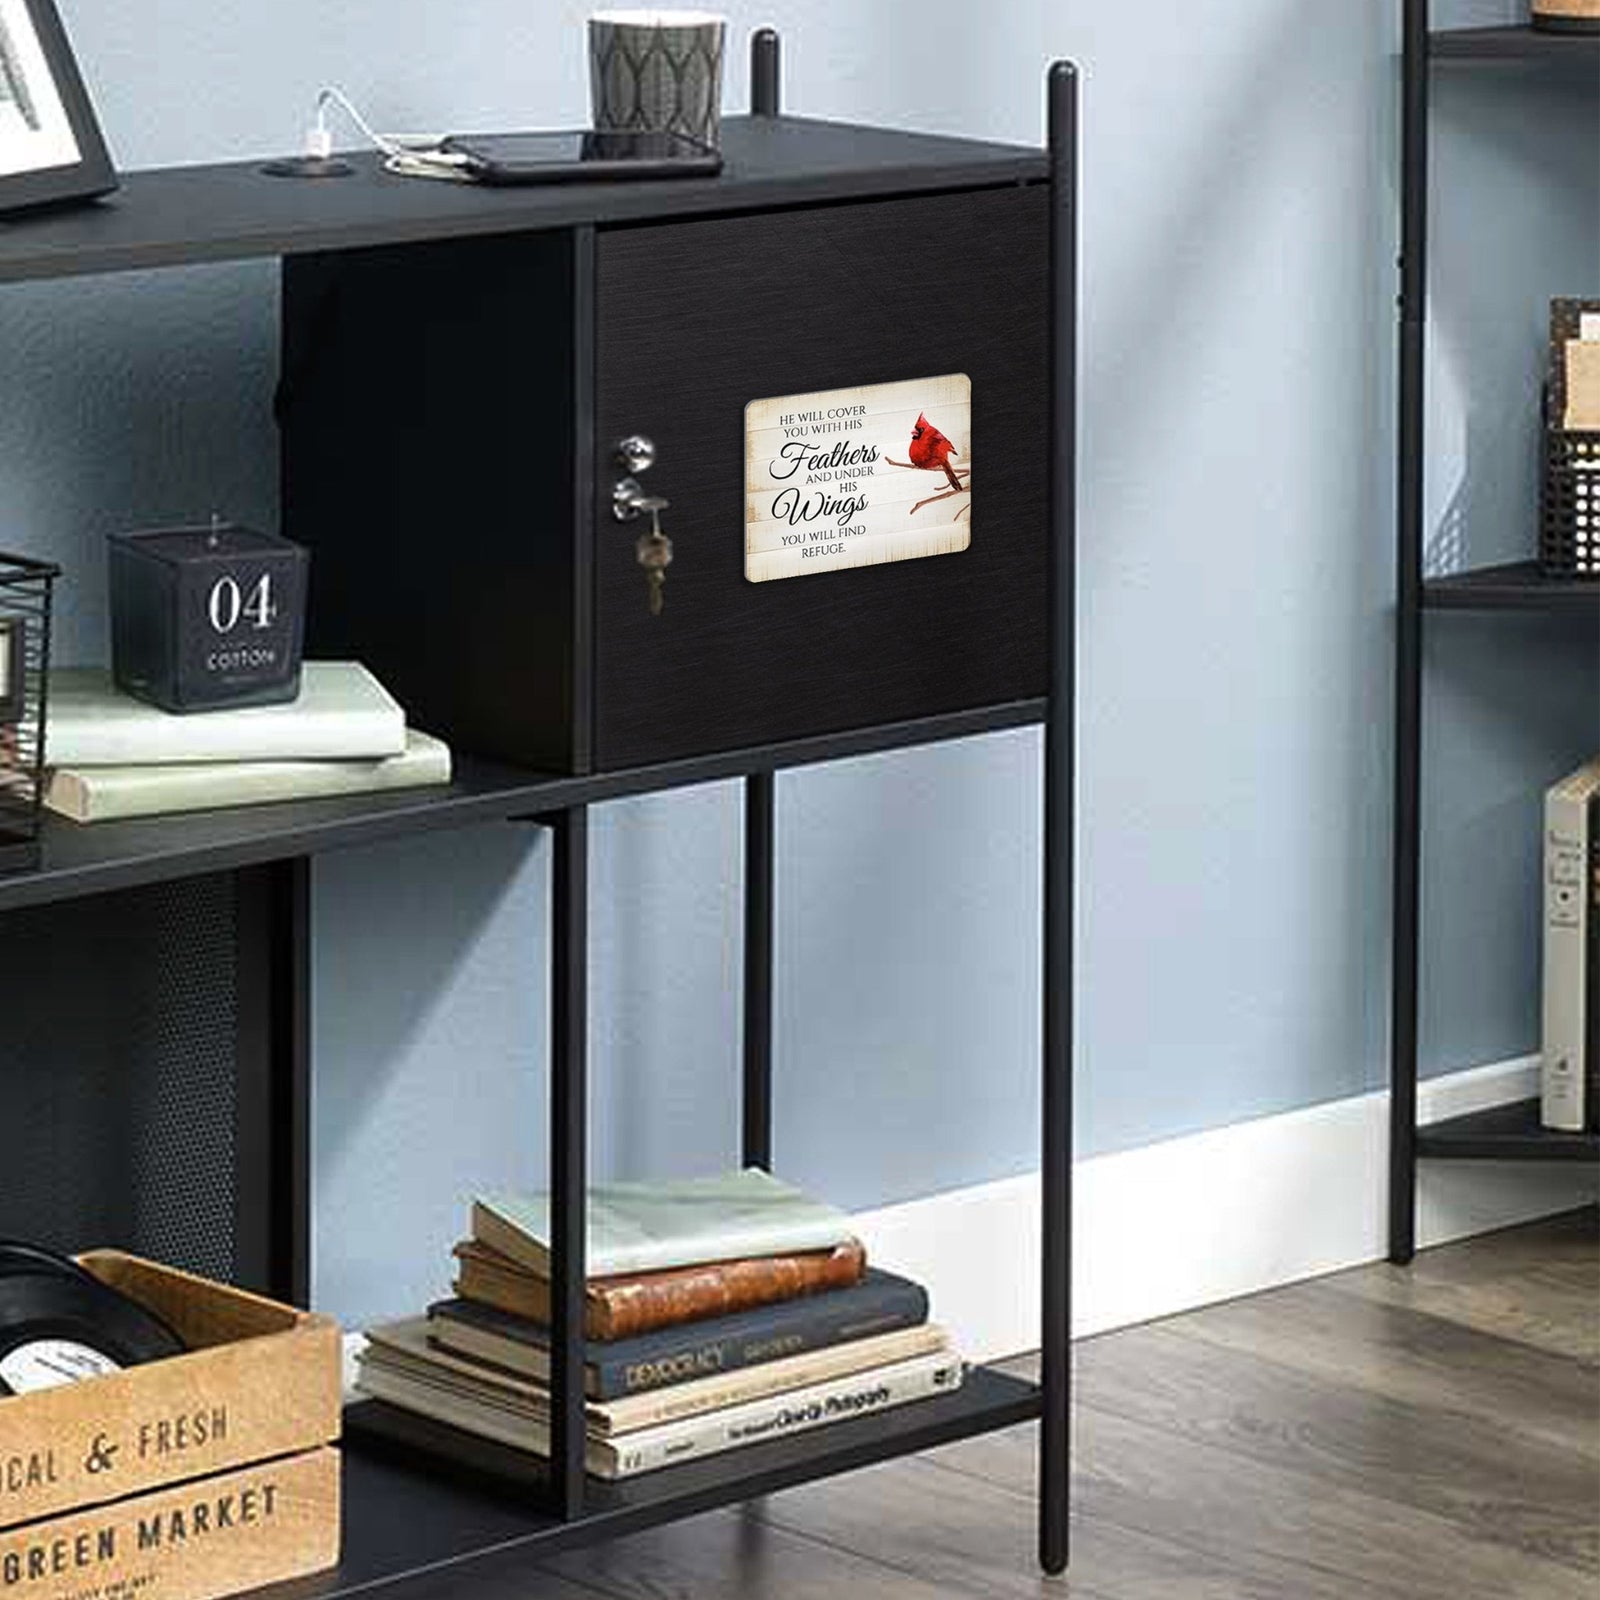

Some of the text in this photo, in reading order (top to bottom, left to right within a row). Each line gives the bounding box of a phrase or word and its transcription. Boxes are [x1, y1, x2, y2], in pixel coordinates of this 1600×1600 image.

[780, 405, 866, 426] HE WILL COVER
[784, 419, 863, 439] YOU WITH HIS
[769, 440, 880, 480] Feathers
[805, 466, 874, 485] AND UNDER
[839, 482, 858, 494] HIS
[771, 487, 869, 526] Wings
[781, 525, 866, 546] YOU WILL FIND
[801, 542, 847, 559] REFUGE.
[208, 572, 278, 634] 04
[0, 1403, 228, 1494] CAL & FRESH
[3, 1525, 116, 1586] GREEN
[136, 1483, 279, 1551] MARKET
